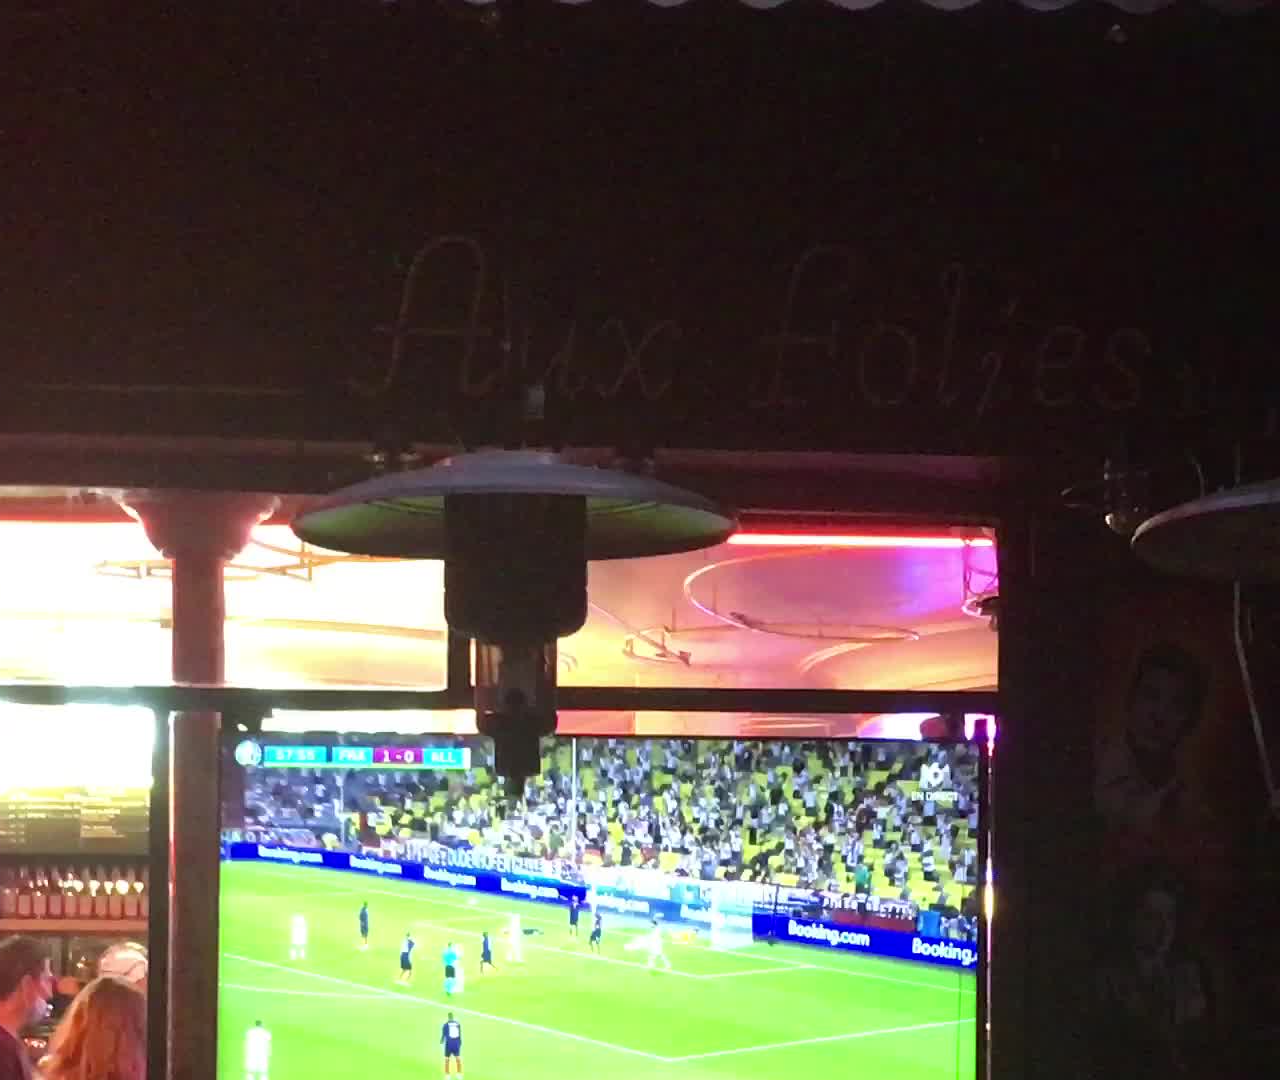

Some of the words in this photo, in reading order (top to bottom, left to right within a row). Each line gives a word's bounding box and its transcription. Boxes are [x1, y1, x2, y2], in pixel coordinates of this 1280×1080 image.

[347, 232, 684, 402] Aux
[788, 920, 870, 947] Booking.com
[912, 937, 977, 966] Booking.
